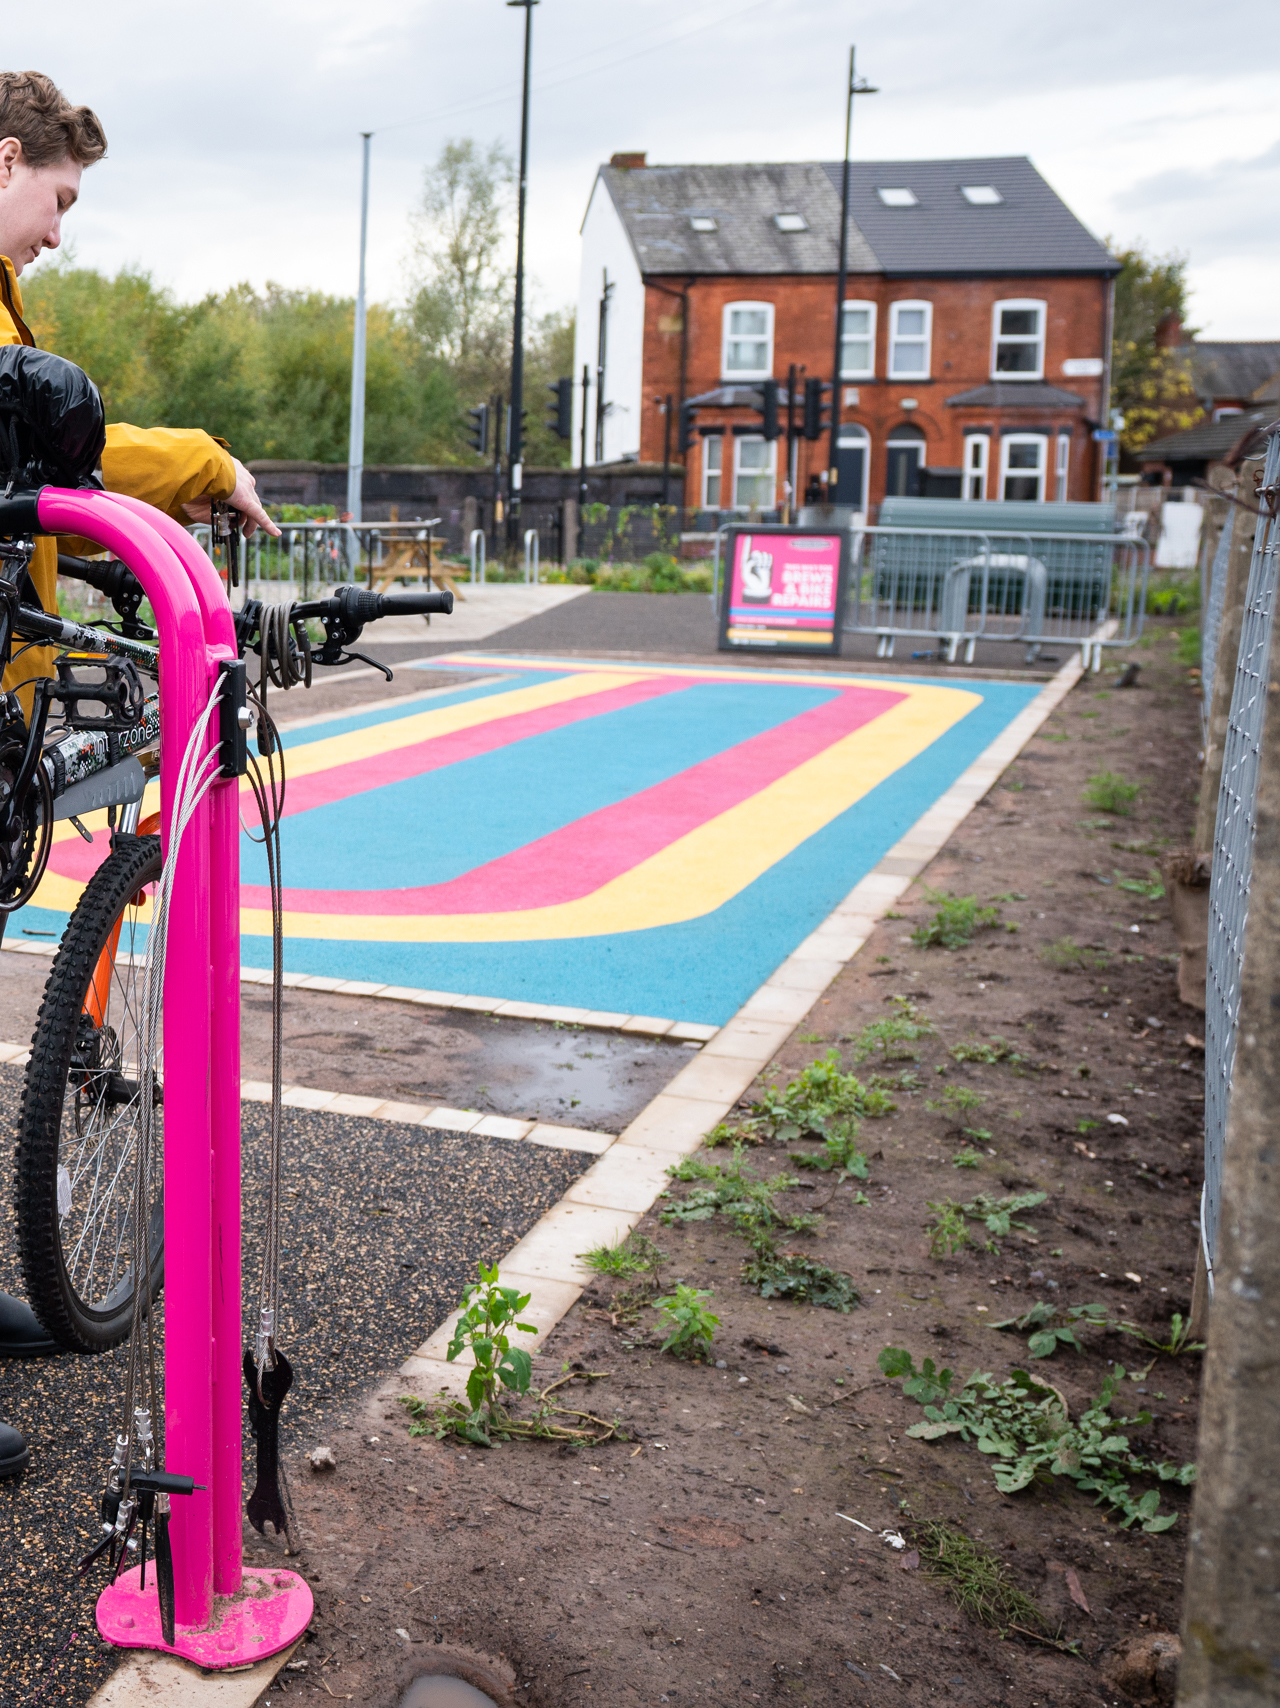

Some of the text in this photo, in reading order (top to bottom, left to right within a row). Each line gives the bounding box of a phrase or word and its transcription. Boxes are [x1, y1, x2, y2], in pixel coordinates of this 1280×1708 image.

[782, 571, 833, 584] BREWS
[799, 583, 832, 595] BIKE
[772, 593, 832, 608] REPAIRS
